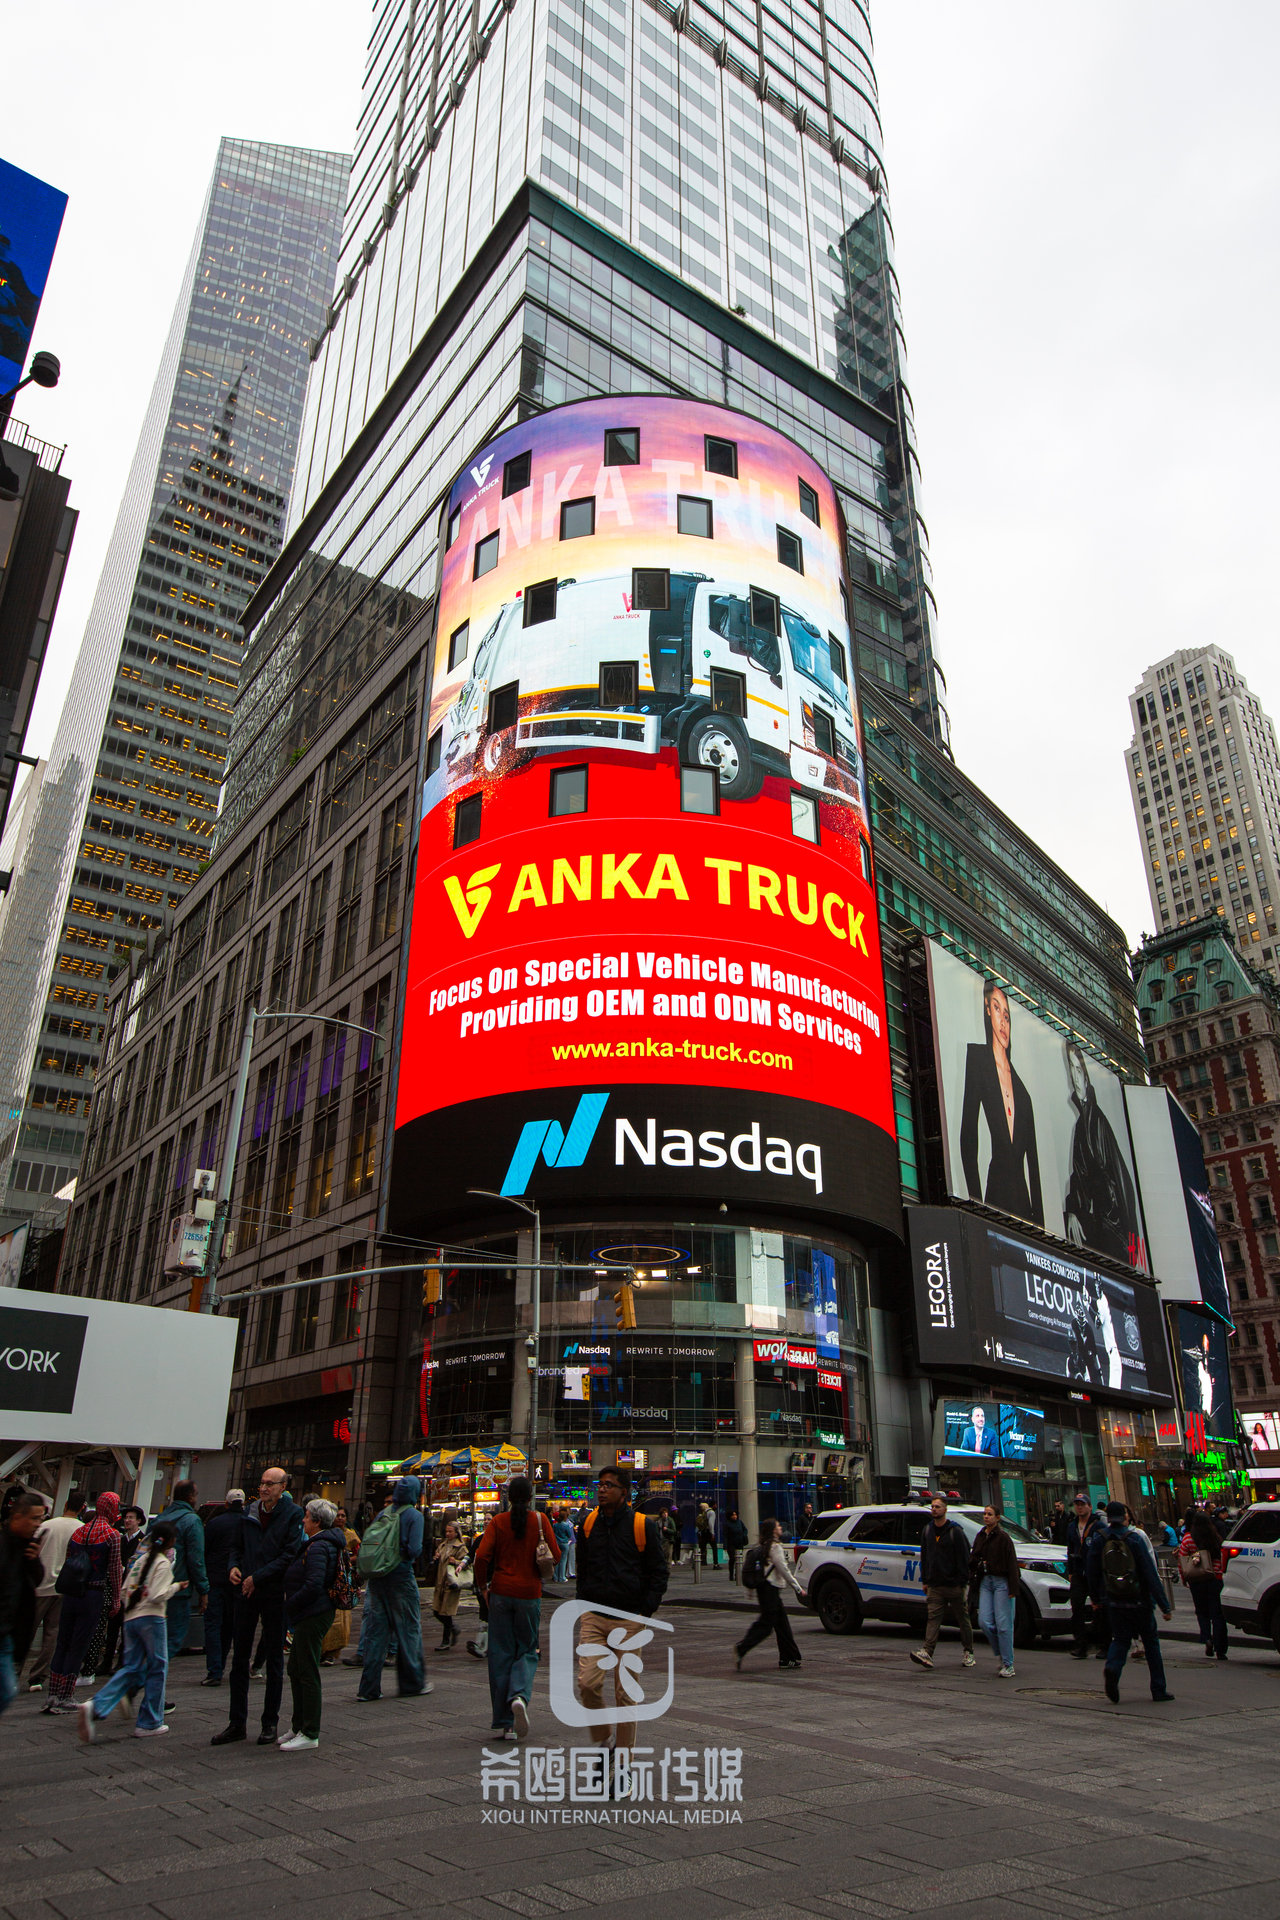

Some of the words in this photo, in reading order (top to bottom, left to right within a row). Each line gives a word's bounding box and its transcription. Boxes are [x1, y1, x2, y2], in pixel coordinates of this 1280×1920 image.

[462, 494, 478, 512] ANKA
[478, 476, 500, 497] TRUCK
[507, 853, 690, 914] ANKA
[704, 857, 869, 958] TRUCK
[428, 976, 483, 1016] Focus
[488, 967, 519, 994] On
[524, 952, 629, 988] Special
[636, 951, 744, 985] Vehicle
[750, 961, 881, 1038] Manufacturing
[460, 995, 579, 1039] Providing
[586, 988, 645, 1018] OEM
[652, 991, 707, 1019] and
[714, 992, 772, 1027] ODM
[777, 1003, 862, 1055] Services
[551, 1037, 793, 1071] www.anka-truck.com
[615, 1118, 823, 1195] Nasdaq
[925, 1242, 948, 1328] LEGORA
[445, 1356, 468, 1366] REWRITE
[578, 1345, 611, 1356] Nasdaq
[626, 1346, 664, 1355] REWRITE
[667, 1347, 716, 1356] TOMORROW
[623, 1405, 669, 1421] Nasdaq
[780, 1412, 802, 1425] Nasdaq
